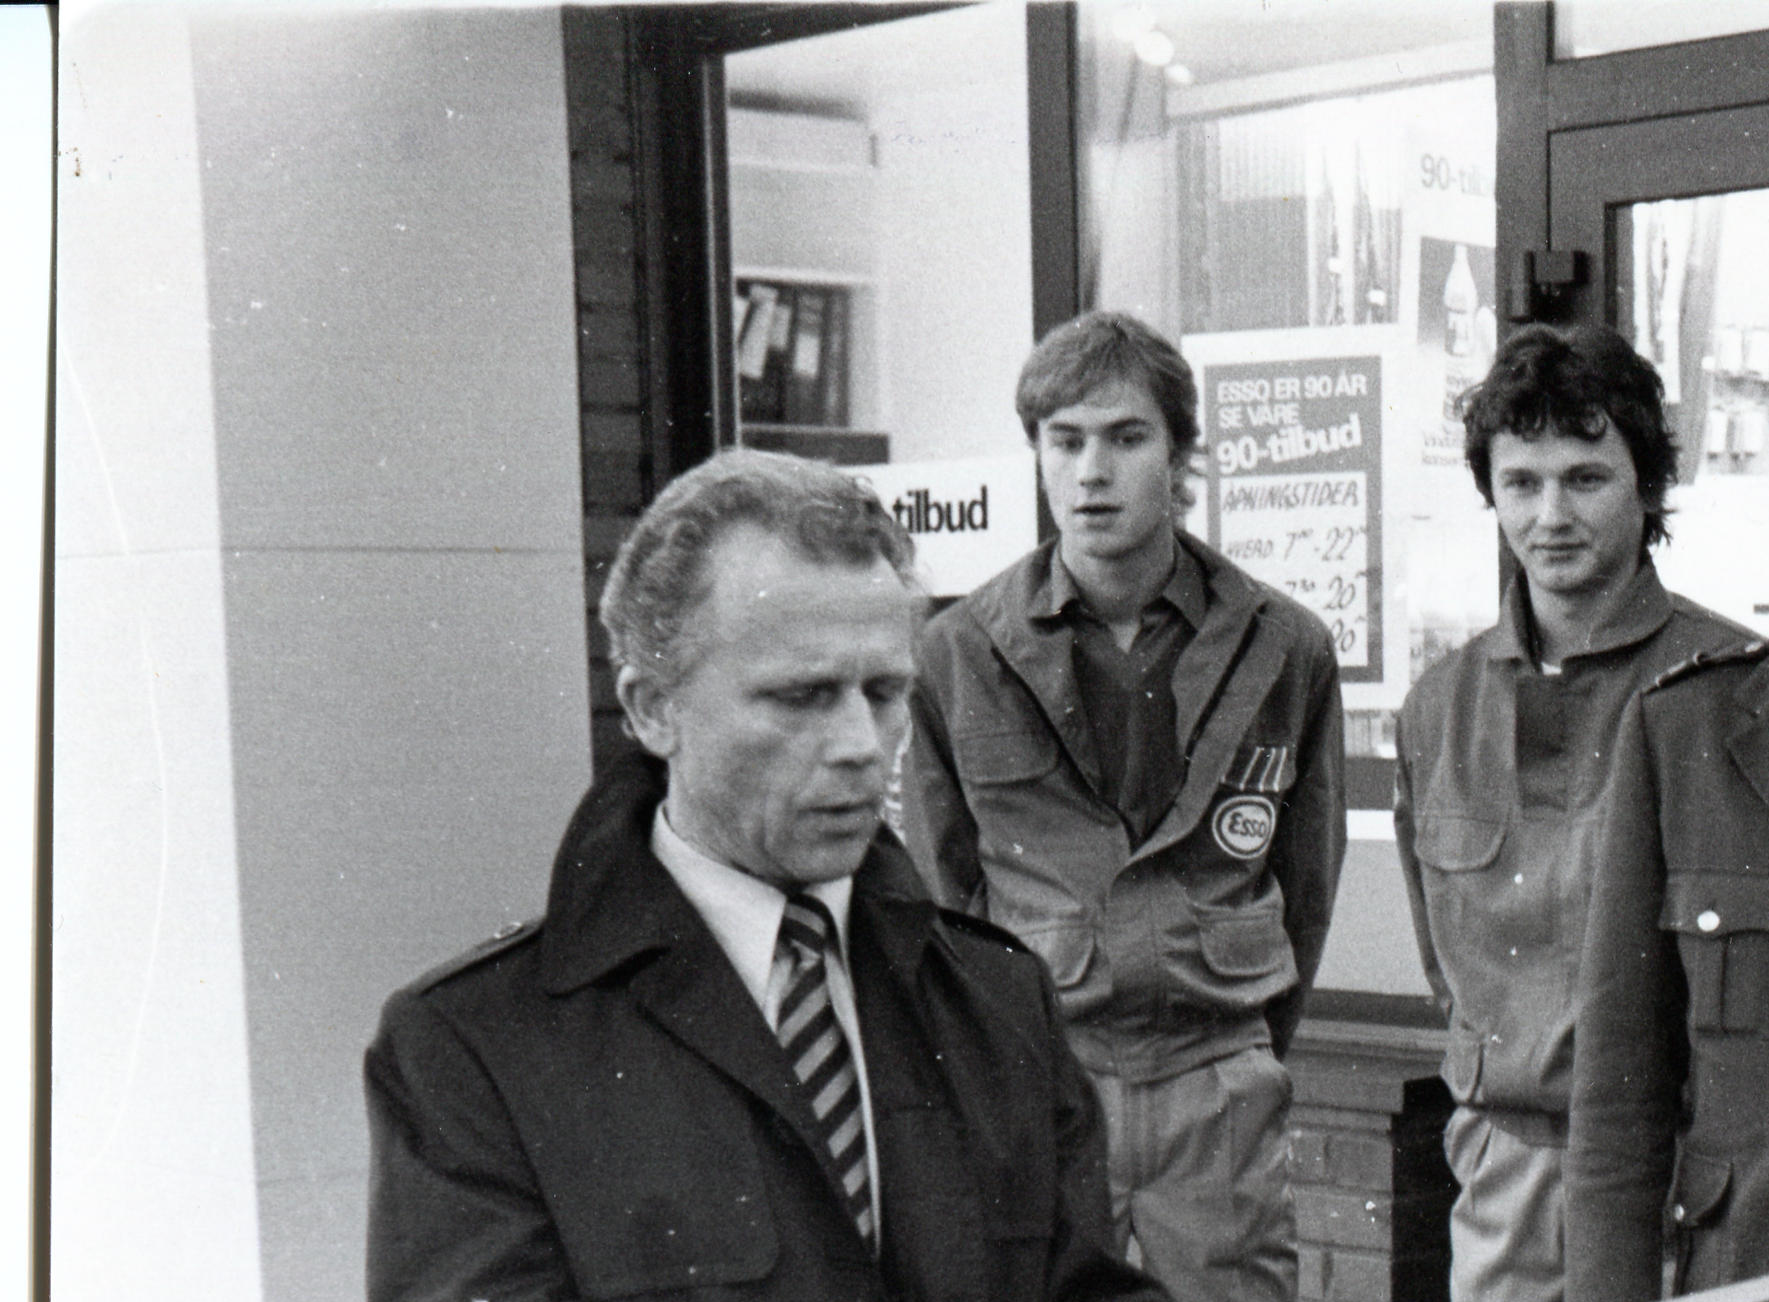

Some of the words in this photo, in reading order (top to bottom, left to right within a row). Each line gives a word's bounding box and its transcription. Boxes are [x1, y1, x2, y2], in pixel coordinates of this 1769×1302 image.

[1217, 378, 1271, 403] ESSO
[1274, 377, 1301, 399] ER
[1304, 375, 1332, 398] 90
[1335, 370, 1368, 397] ÅR
[1217, 405, 1243, 428] SE
[1216, 412, 1362, 475] 90-tilbud
